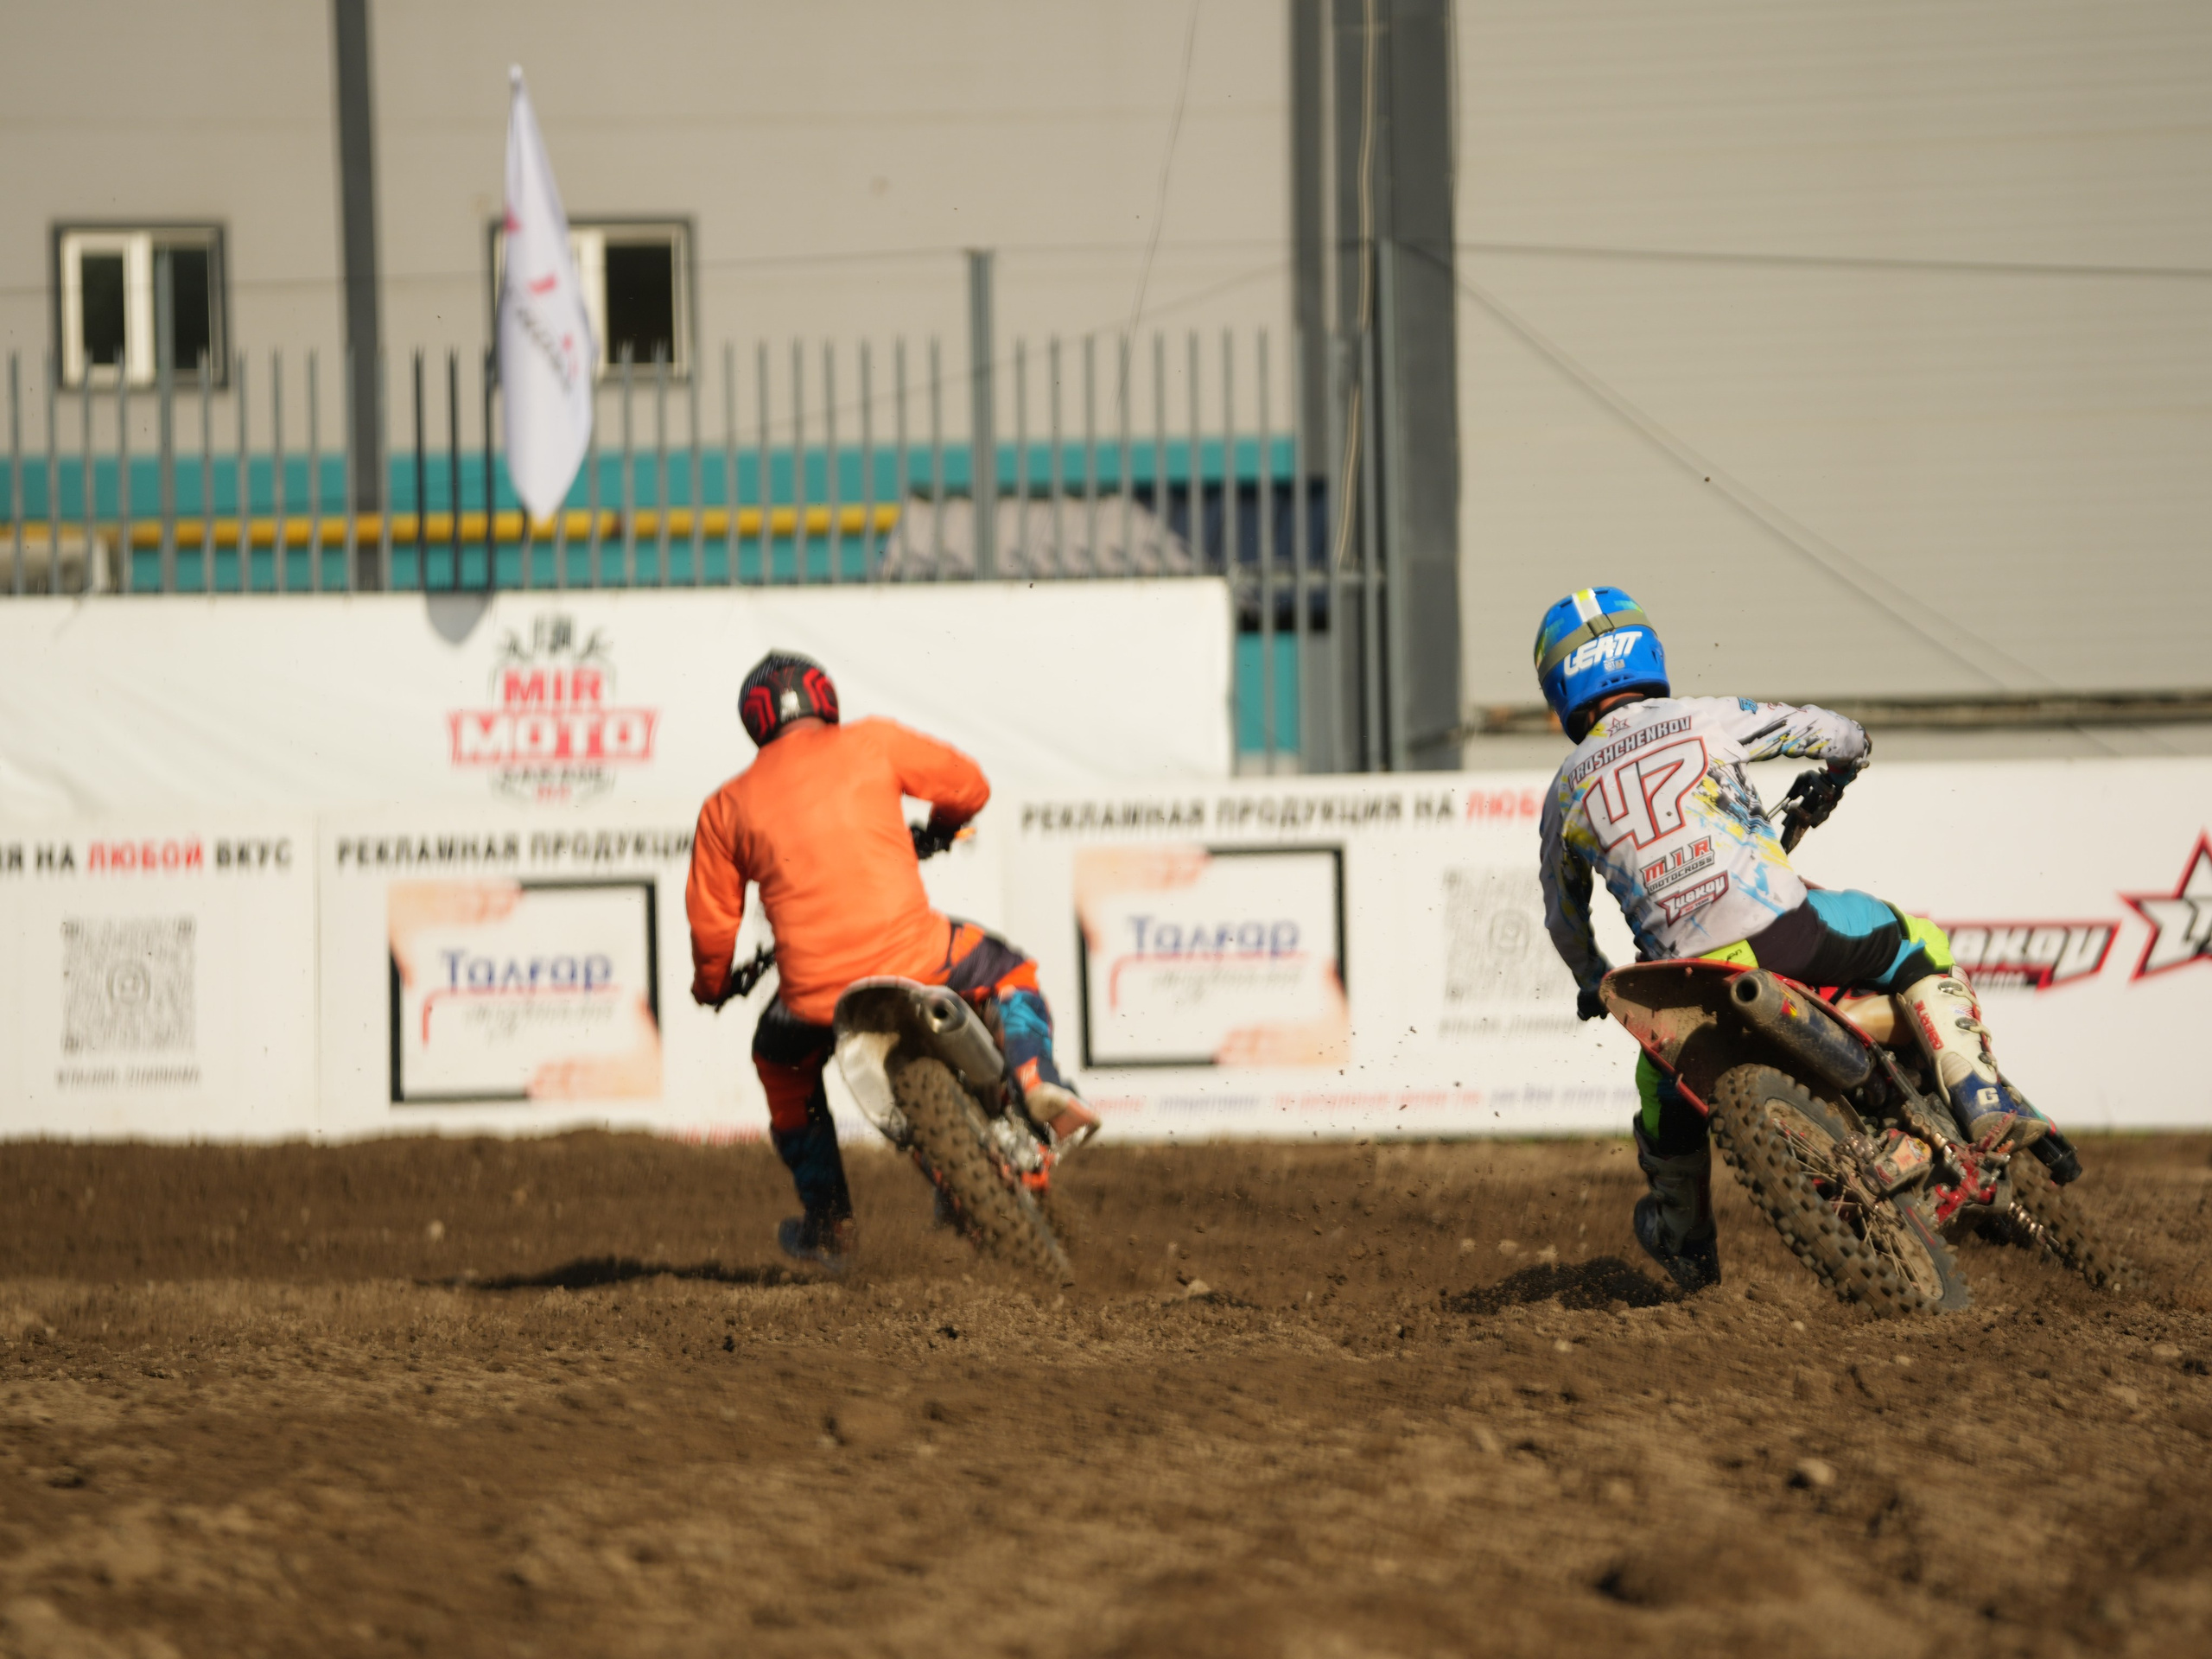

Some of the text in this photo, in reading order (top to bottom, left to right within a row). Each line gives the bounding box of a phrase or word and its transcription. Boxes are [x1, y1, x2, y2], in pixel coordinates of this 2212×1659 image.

[1564, 632, 1643, 677] LEATT
[503, 668, 601, 707] MIR
[460, 712, 645, 757] MOTO
[1568, 716, 1691, 791] PROSHCHENKOV
[1414, 794, 1453, 821] НА
[1466, 790, 1548, 823] ЛЮБ
[1583, 736, 1708, 853] 47
[35, 839, 76, 873] НА
[88, 831, 205, 874] ЛЮБОЙ
[215, 836, 294, 872] ВКУС
[530, 827, 692, 869] ПРОДУКЦИ
[1649, 855, 1713, 892] MOTOCROSS
[1945, 926, 2111, 979] BKOV
[1913, 999, 1944, 1051] GAERNE
